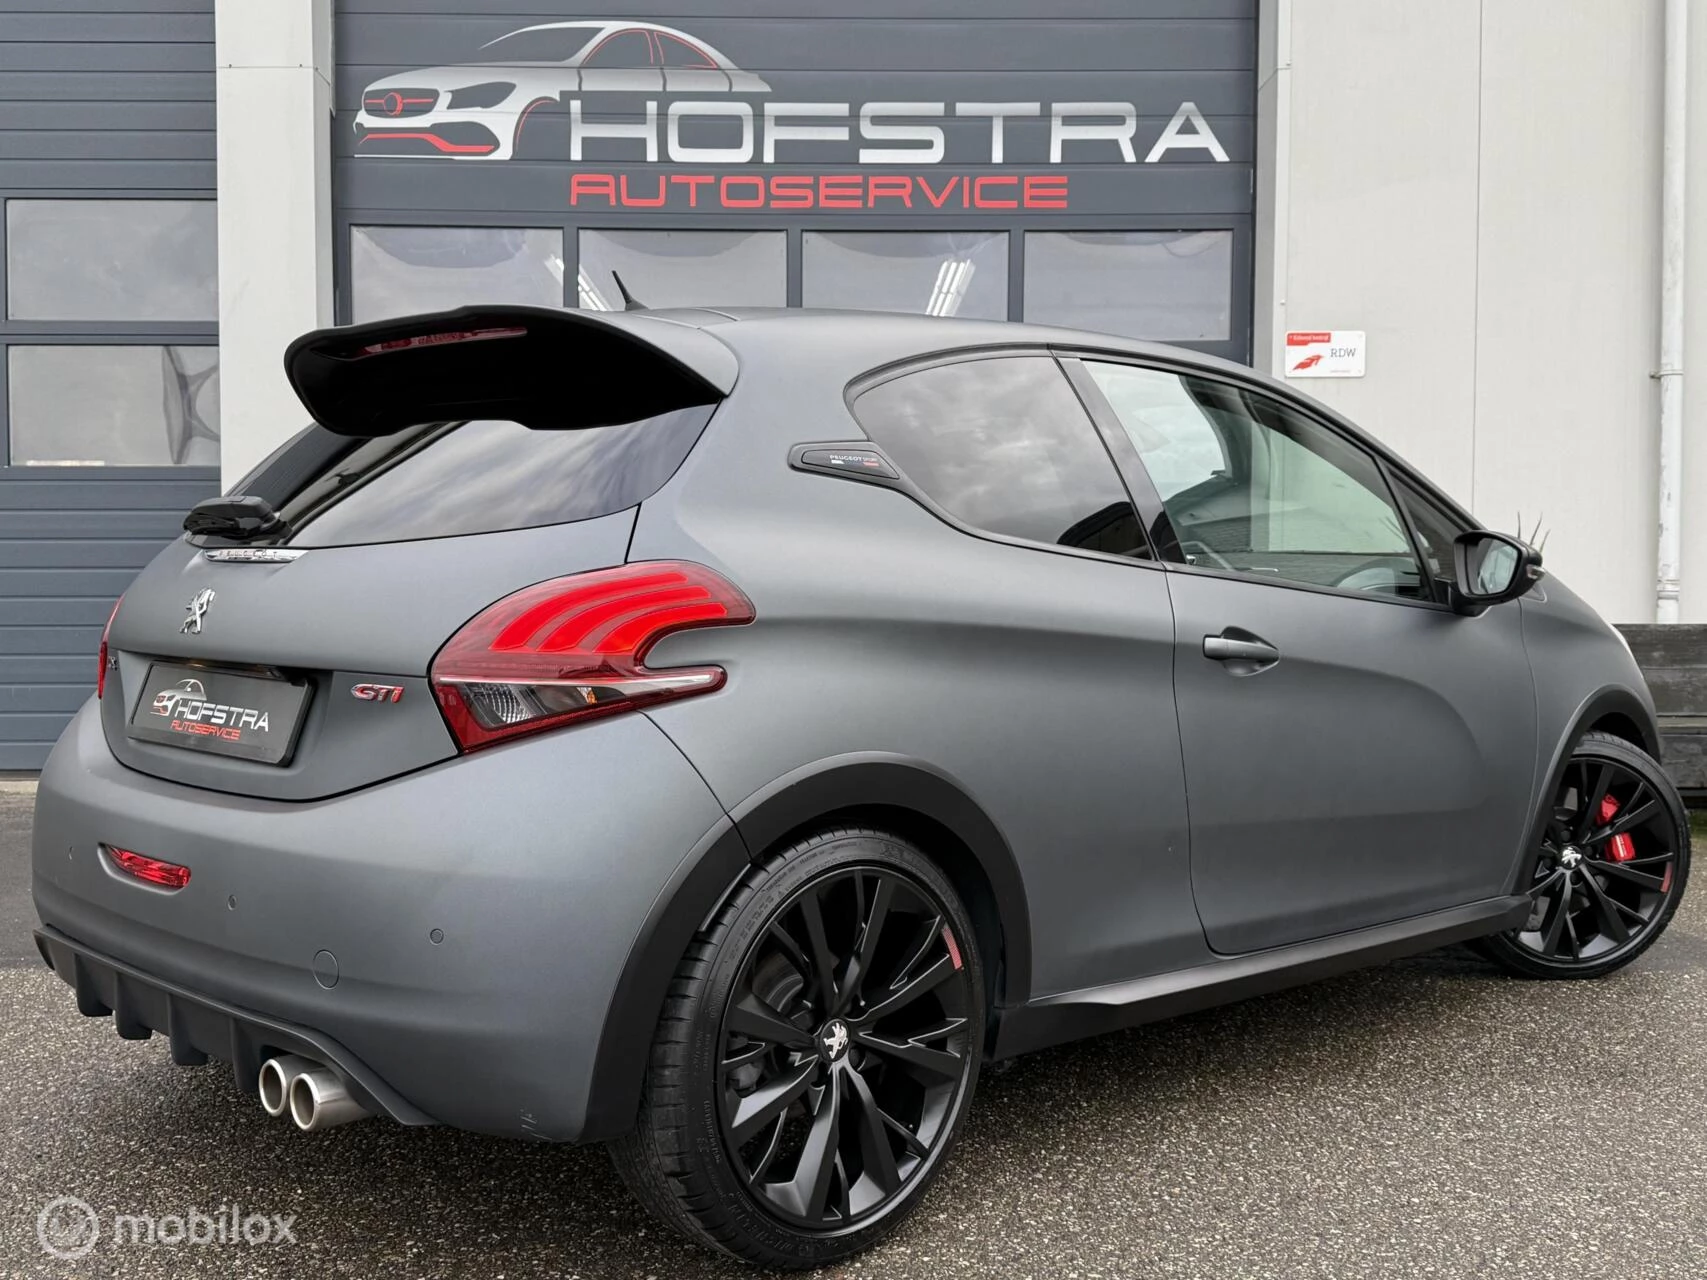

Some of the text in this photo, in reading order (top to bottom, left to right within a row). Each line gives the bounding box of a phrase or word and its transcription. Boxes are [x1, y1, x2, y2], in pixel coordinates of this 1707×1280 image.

[570, 101, 1230, 163] HOFSTRA
[570, 174, 1069, 209] AUTOSERVICE
[1330, 347, 1356, 358] RDW
[171, 719, 241, 740] AUTOSERVICE
[174, 699, 269, 732] HOFSTRA
